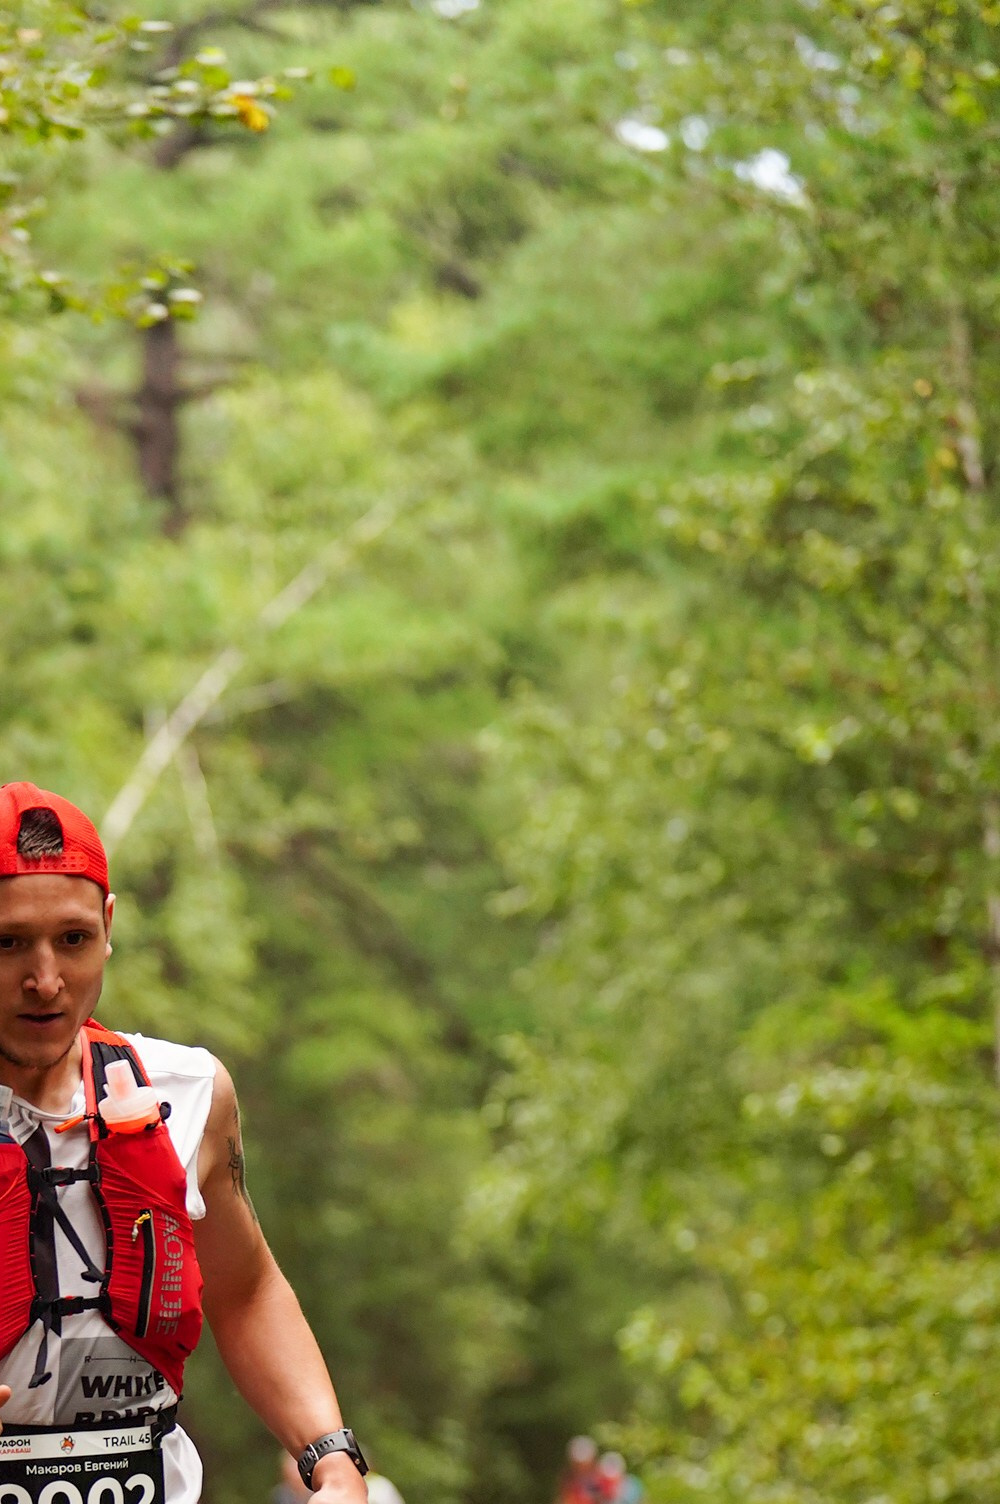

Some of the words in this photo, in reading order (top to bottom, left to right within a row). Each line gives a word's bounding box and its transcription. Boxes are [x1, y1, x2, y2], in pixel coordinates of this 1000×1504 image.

[81, 1370, 165, 1398] WHITE
[103, 1434, 136, 1448] TRAIL
[138, 1432, 151, 1444] 45
[25, 1461, 81, 1476] Макаров
[84, 1457, 129, 1472] Евгений
